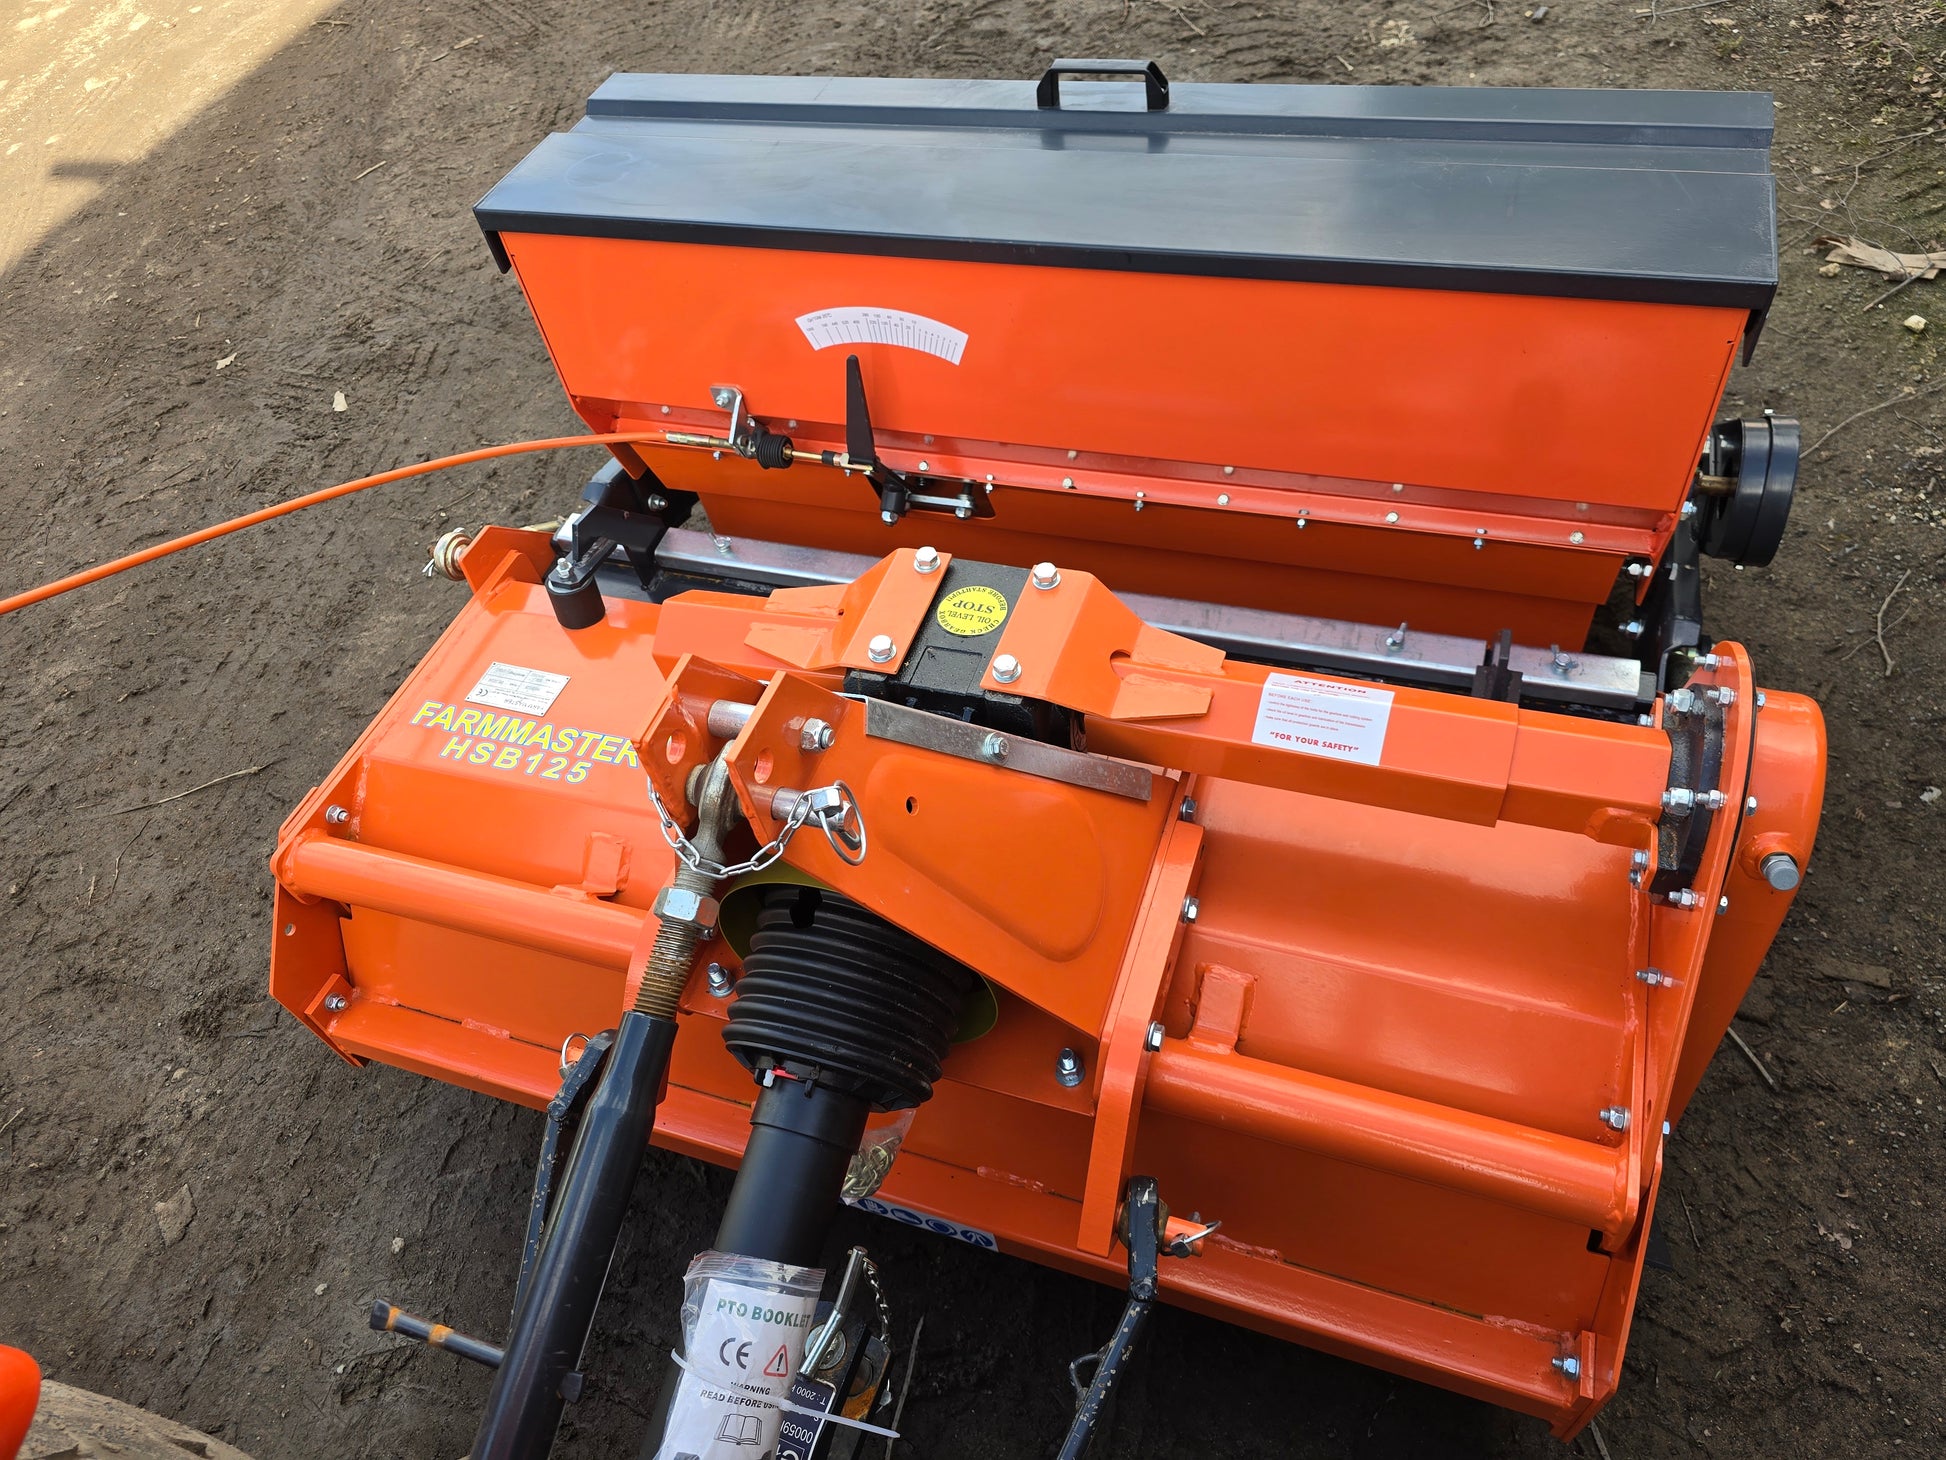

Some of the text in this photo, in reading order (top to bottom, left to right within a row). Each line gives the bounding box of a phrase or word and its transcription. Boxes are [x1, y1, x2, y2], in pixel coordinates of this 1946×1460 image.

[952, 600, 995, 614] STOP
[988, 589, 1007, 611] BEFORE
[939, 610, 1000, 634] CHECK GEARBOX
[947, 610, 991, 624] OIL LEVEL
[1294, 680, 1367, 694] ATTENTION
[410, 700, 640, 768] FARMMASTER
[1295, 735, 1319, 746] YOUR
[440, 736, 592, 784] HSB125
[716, 1297, 811, 1328] PTO BOOKLET
[700, 1389, 726, 1402] READ
[727, 1395, 763, 1409] BEFORE
[796, 1386, 817, 1401] 2000
